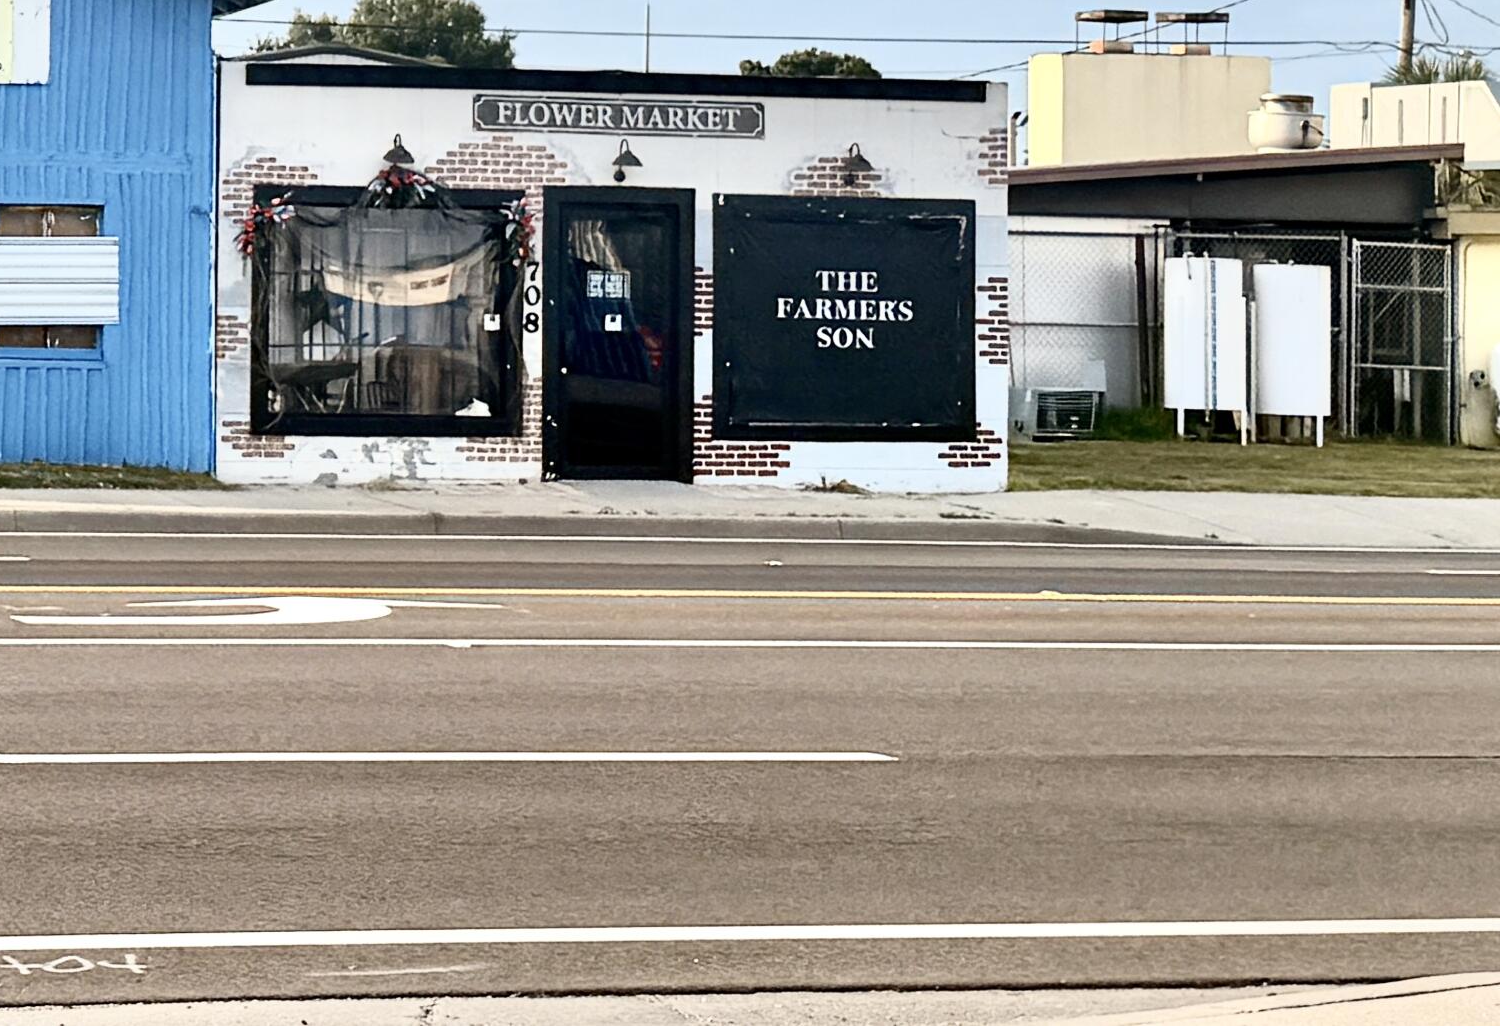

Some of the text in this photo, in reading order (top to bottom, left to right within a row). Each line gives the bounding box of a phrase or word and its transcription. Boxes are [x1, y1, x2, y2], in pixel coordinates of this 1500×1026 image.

[496, 101, 741, 132] FLOWER MARKET
[815, 270, 879, 293] THE
[523, 261, 541, 334] 708
[816, 326, 876, 350] SON
